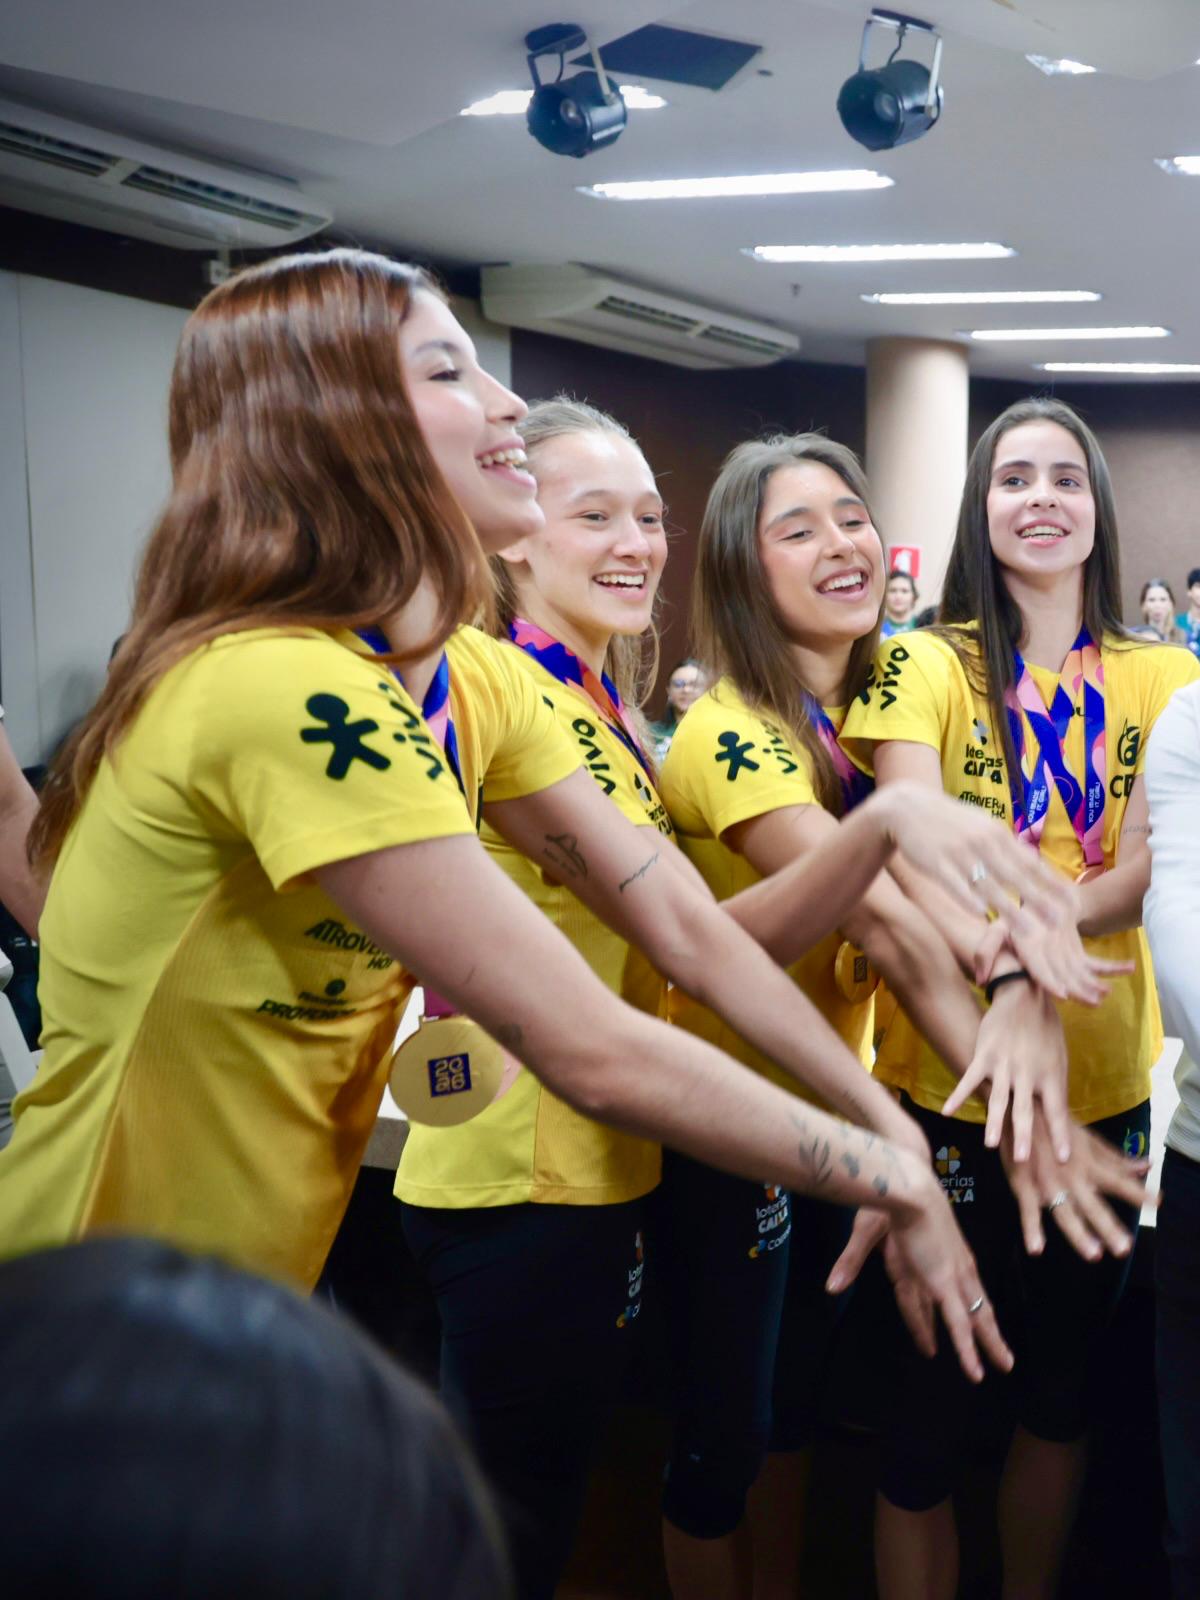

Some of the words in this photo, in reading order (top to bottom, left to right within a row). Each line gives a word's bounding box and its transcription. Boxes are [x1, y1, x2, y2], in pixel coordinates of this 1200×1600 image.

[876, 646, 910, 711] vivo
[378, 682, 445, 781] viv
[572, 718, 616, 796] vivo
[304, 917, 391, 957] ATROV
[939, 1174, 975, 1187] erias
[943, 1188, 975, 1203] IXA
